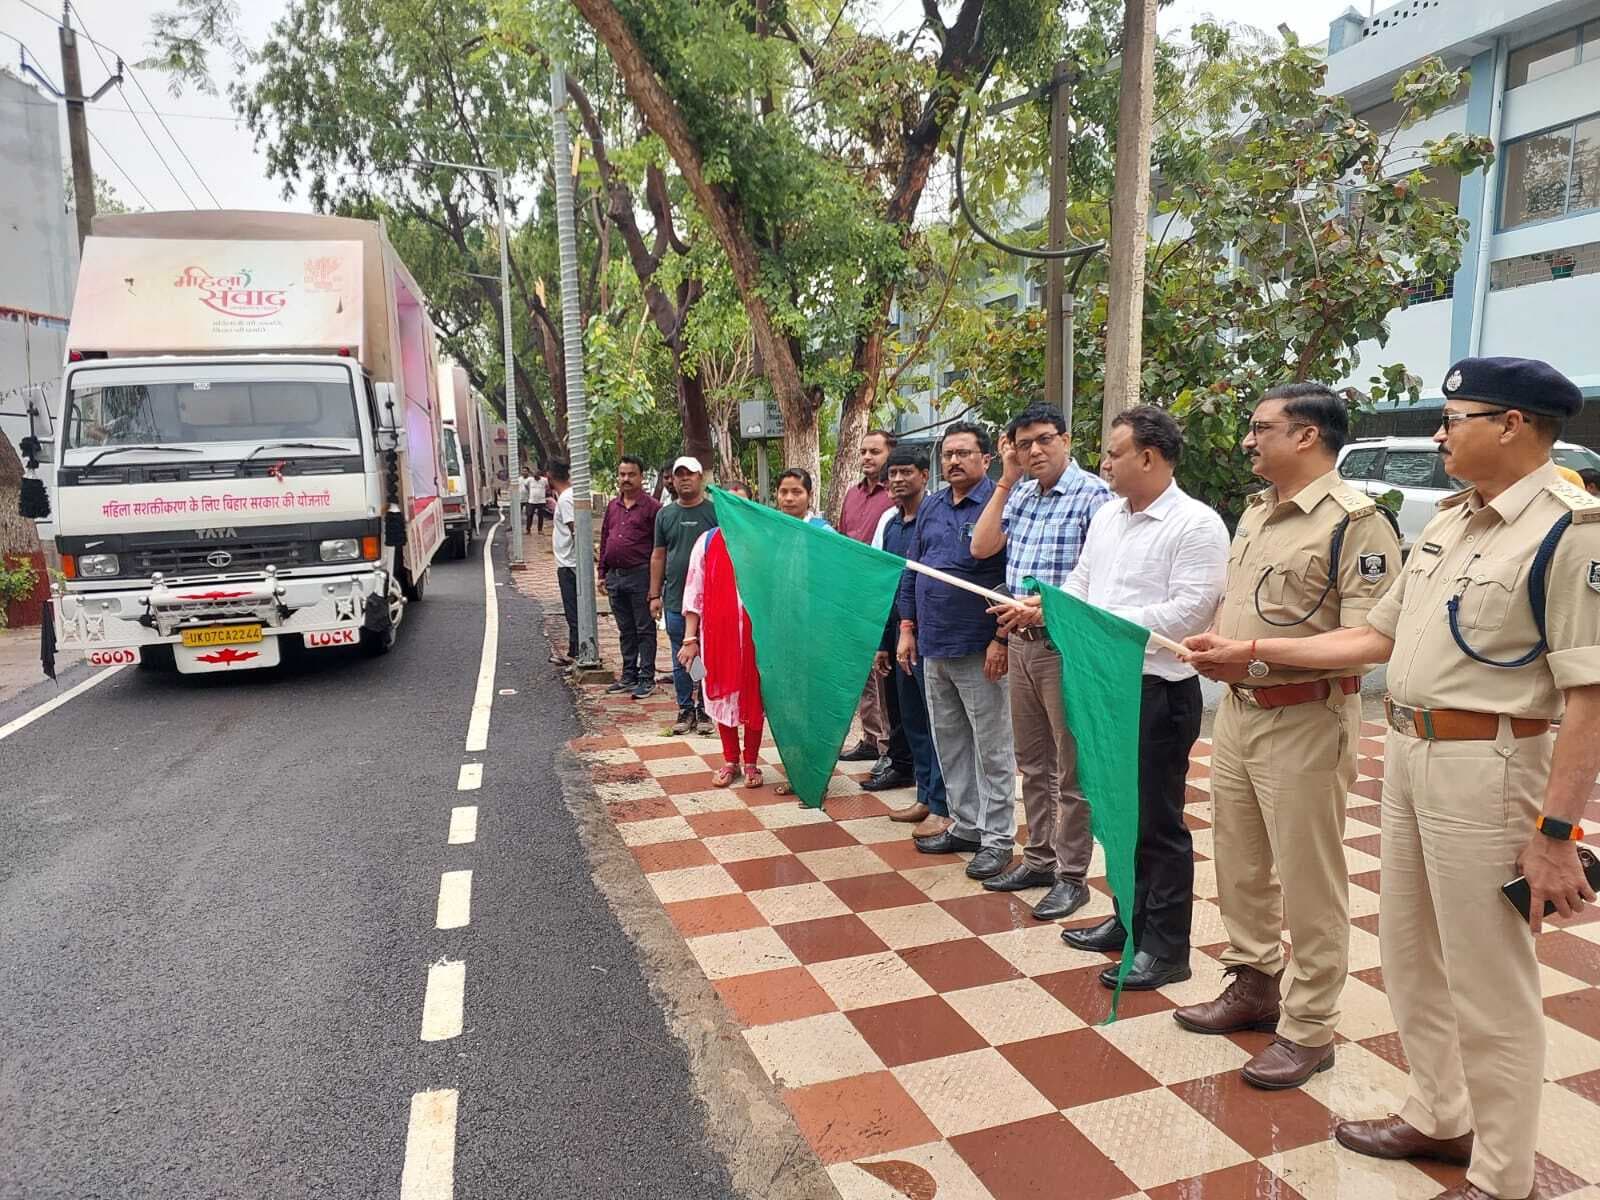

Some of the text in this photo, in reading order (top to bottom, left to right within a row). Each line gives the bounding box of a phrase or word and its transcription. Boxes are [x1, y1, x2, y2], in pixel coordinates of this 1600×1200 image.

[199, 286, 288, 315] संवाद
[102, 500, 131, 518] महिला
[189, 496, 199, 512] के
[201, 495, 220, 512] लिए
[223, 494, 248, 511] बिहार
[250, 496, 280, 509] सरकार
[282, 491, 295, 508] की
[195, 527, 238, 540] TATA
[310, 629, 354, 646] LOCK
[91, 650, 135, 665] GOOD
